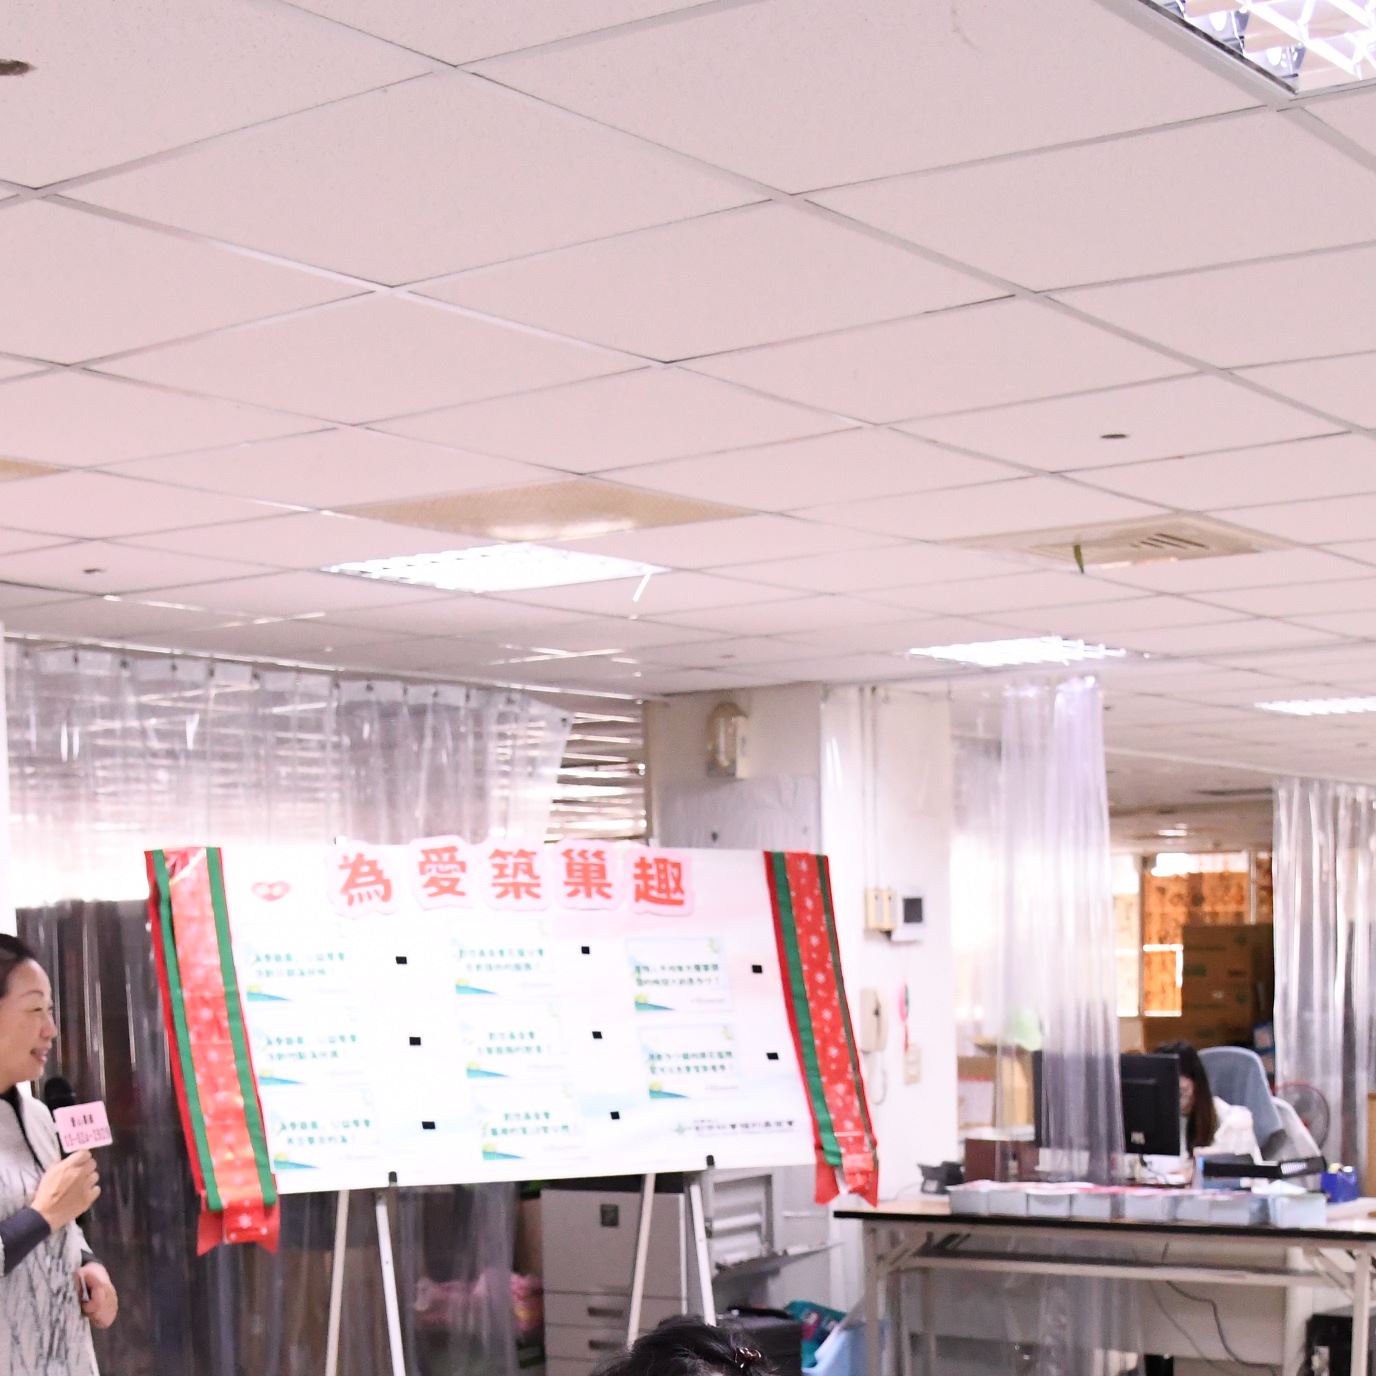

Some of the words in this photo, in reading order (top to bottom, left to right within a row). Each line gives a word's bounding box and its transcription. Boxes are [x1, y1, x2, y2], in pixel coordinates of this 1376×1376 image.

[338, 845, 686, 908] 為愛築巢趣
